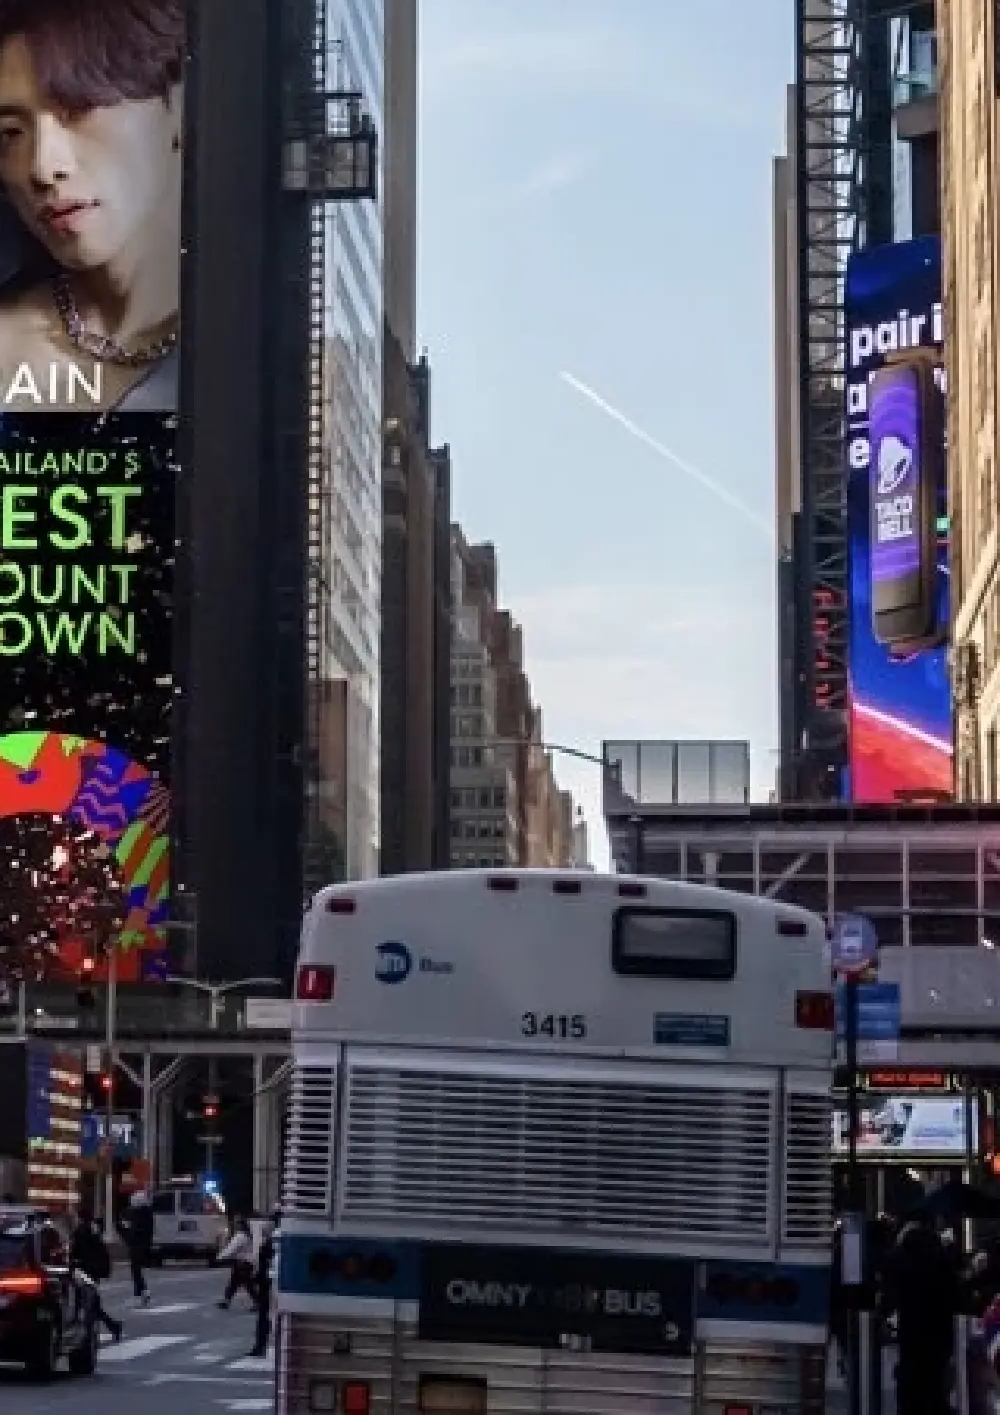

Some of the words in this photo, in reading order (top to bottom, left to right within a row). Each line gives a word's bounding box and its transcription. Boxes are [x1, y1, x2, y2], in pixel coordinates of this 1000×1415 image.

[852, 308, 926, 366] pair
[875, 495, 913, 518] TACO
[877, 516, 913, 542] BELL
[521, 1011, 587, 1038] 3415
[447, 1278, 531, 1306] OMNY
[605, 1289, 662, 1316] BUS
